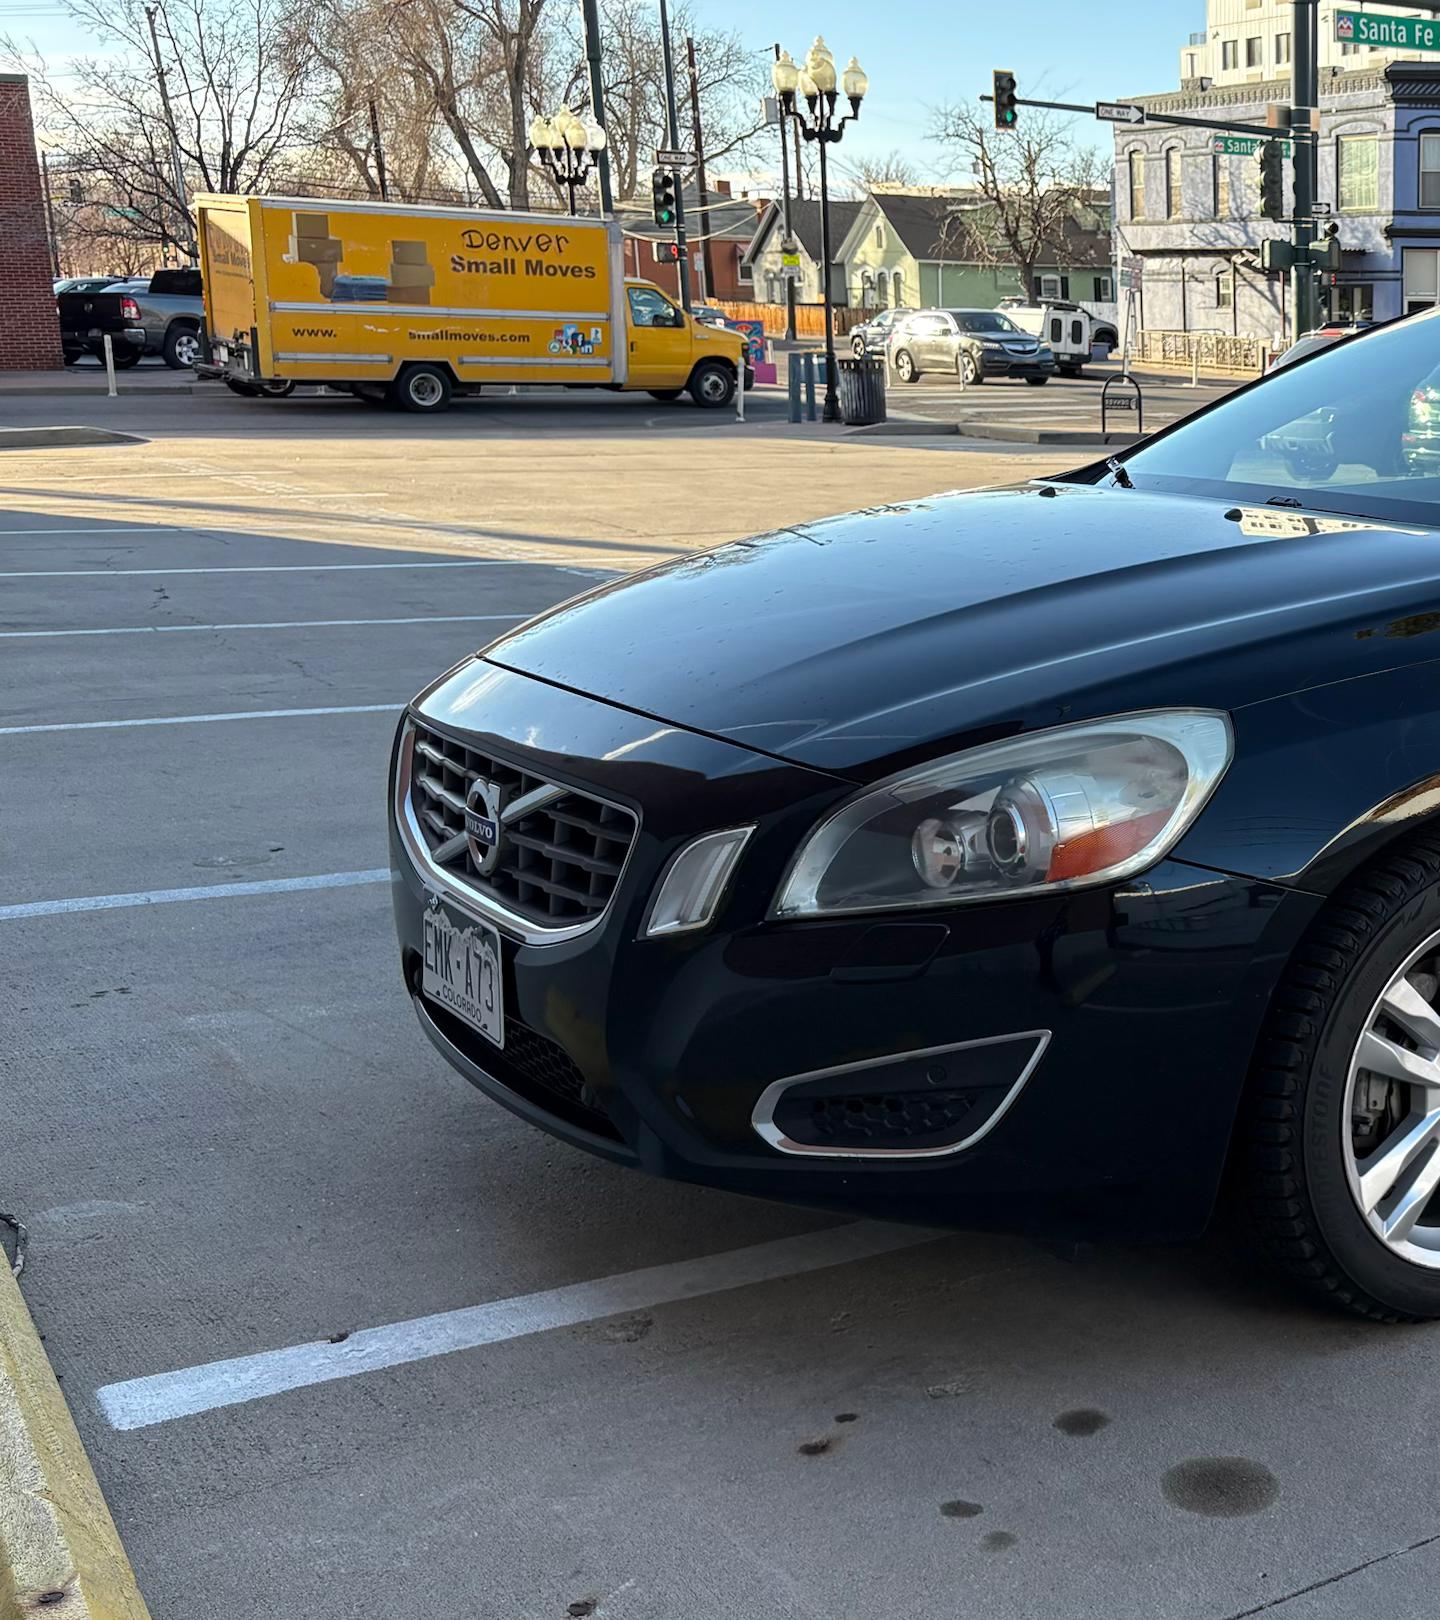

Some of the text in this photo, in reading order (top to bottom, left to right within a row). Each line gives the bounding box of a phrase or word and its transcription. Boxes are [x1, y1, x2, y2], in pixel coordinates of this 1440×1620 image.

[1359, 18, 1407, 43] Santa
[1415, 23, 1434, 46] Fe
[1115, 109, 1131, 117] WAY
[1227, 139, 1257, 153] Santa
[461, 229, 570, 253] Denver
[451, 255, 597, 279] Small Moves
[292, 328, 530, 343] www. smallmoves.com
[466, 817, 493, 839] VOLVO
[442, 983, 482, 1023] COLORADO
